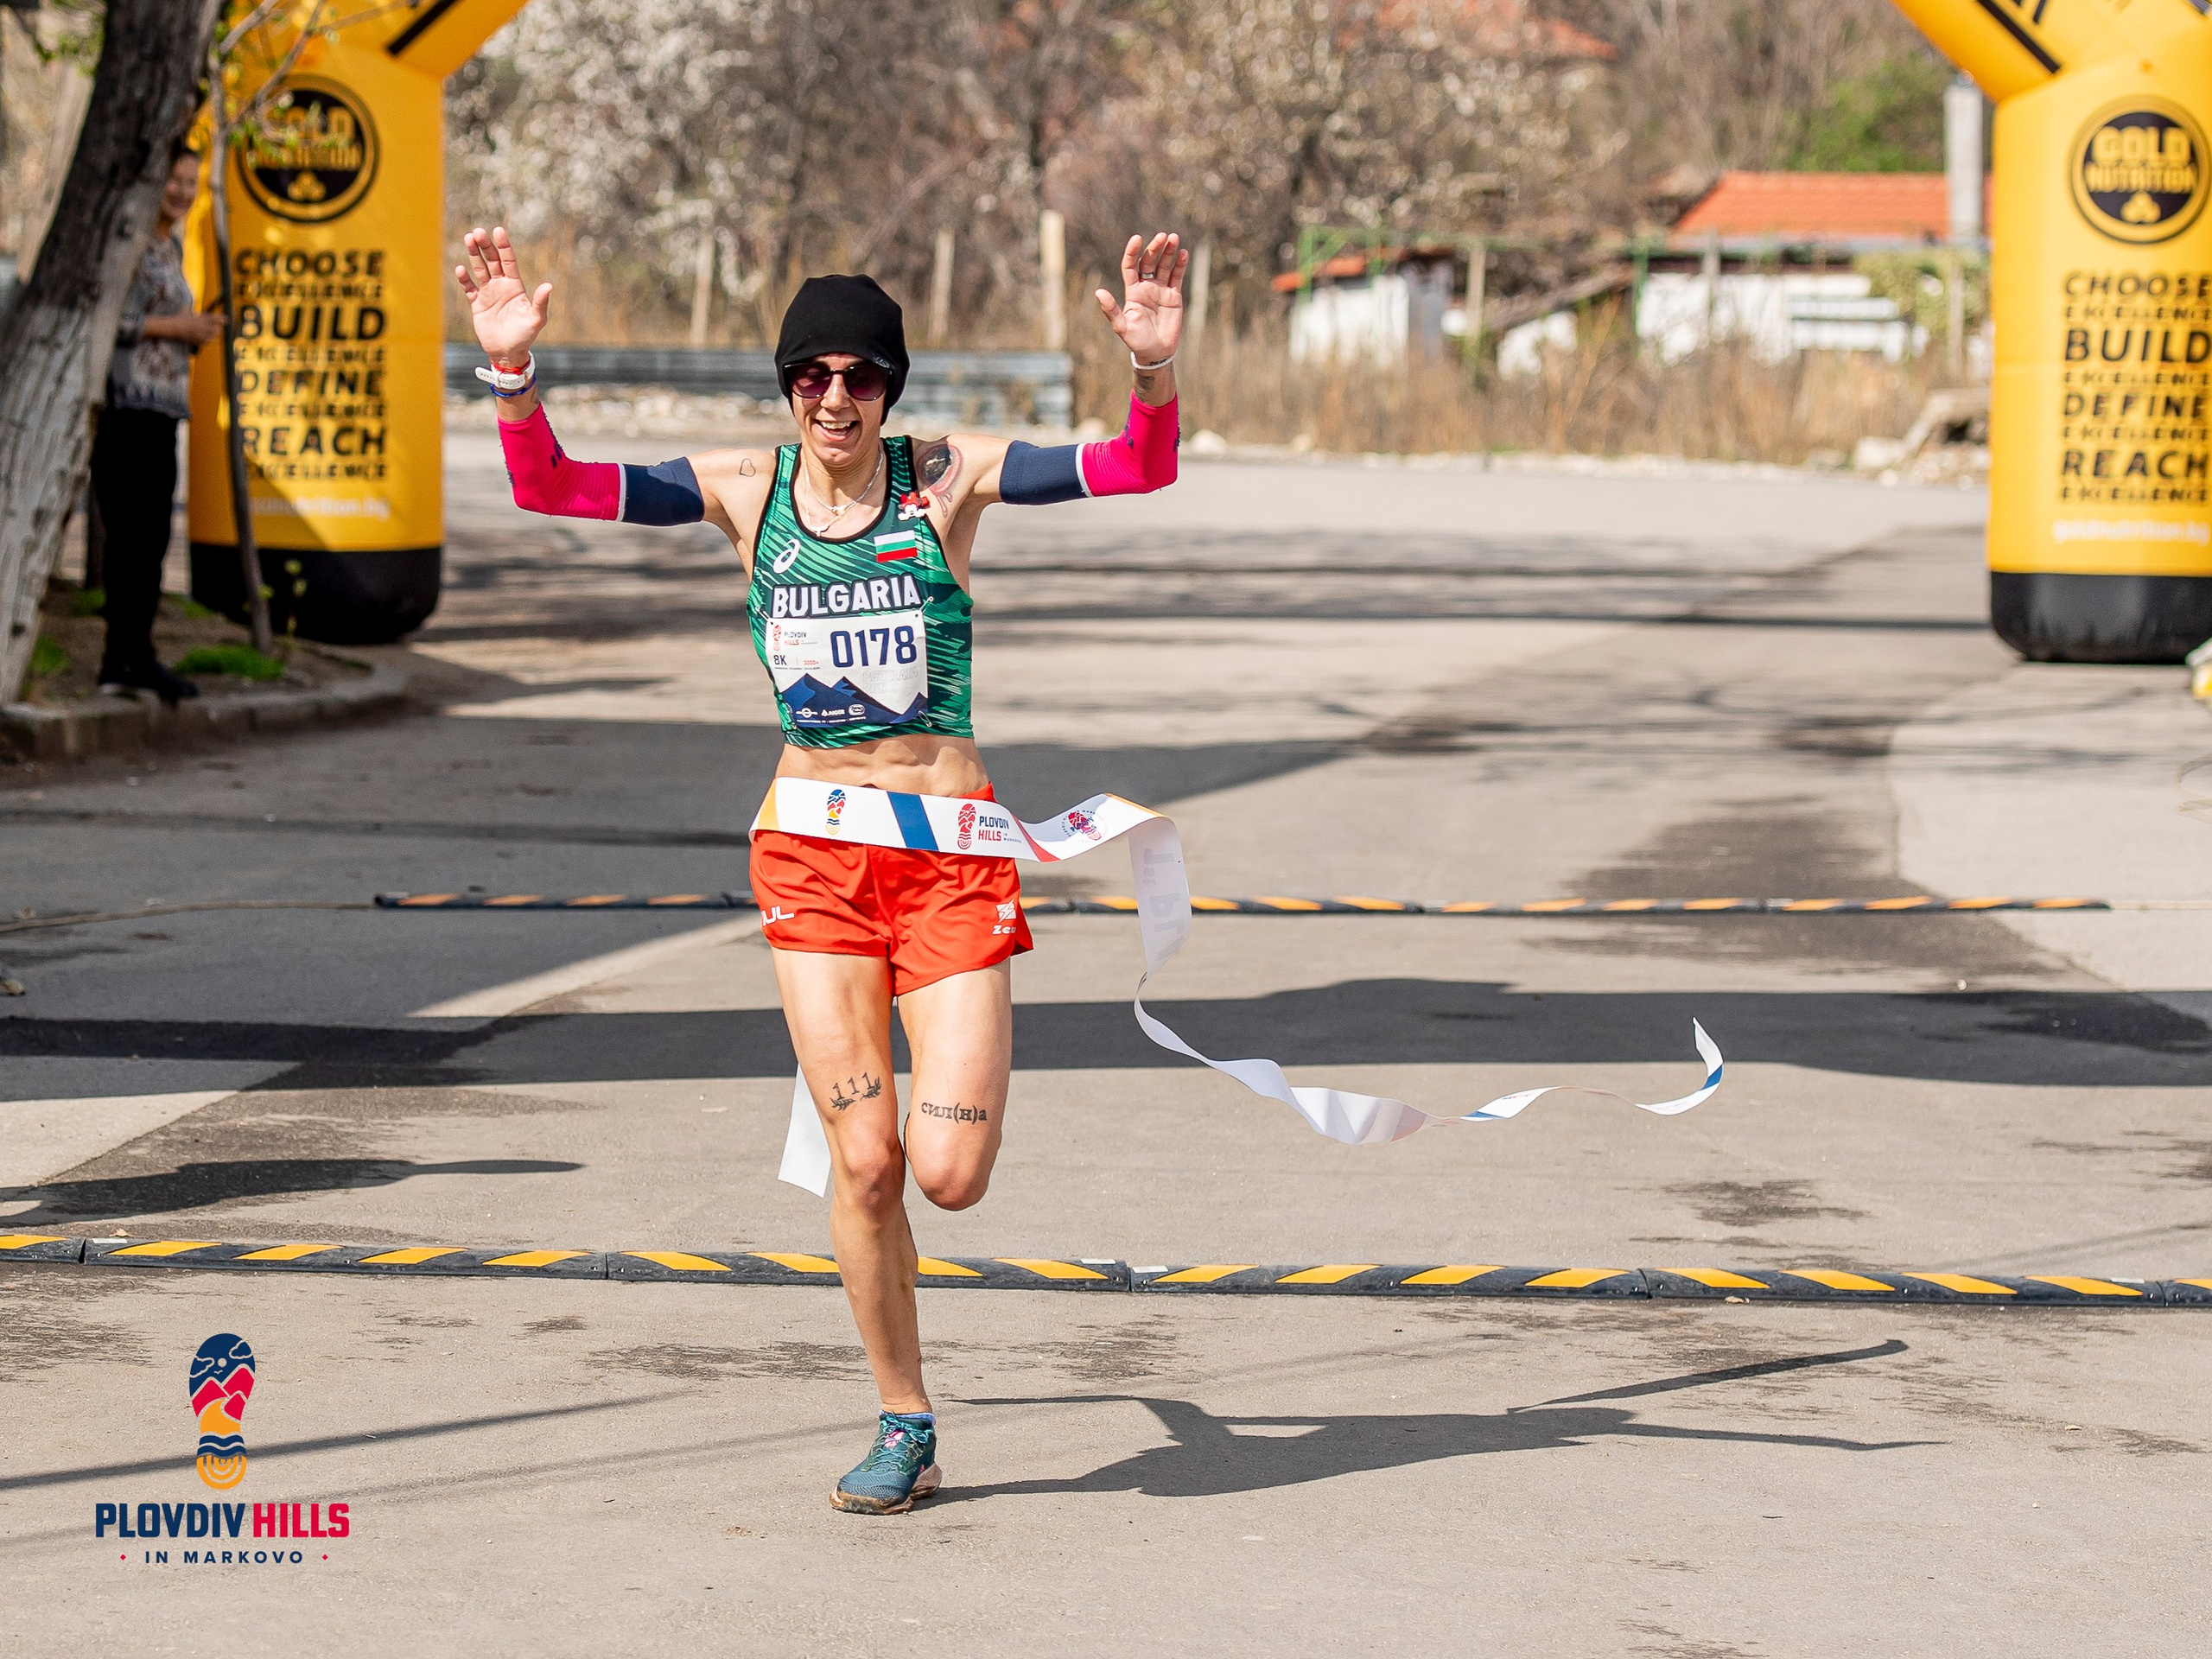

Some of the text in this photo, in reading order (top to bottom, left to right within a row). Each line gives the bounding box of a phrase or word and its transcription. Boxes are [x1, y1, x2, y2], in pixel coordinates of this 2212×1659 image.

[2092, 125, 2191, 164] GOLD
[236, 249, 385, 277] CHOOSE
[2064, 272, 2211, 298] CHOOSE
[240, 305, 385, 340] BUILD
[2064, 329, 2212, 363] BUILD
[240, 369, 385, 397] DEFINE
[2063, 392, 2209, 418] DEFINE
[242, 426, 387, 456] REACH
[2062, 448, 2209, 478] REACH
[771, 574, 922, 619] BULGARIA
[773, 654, 787, 665] 8K
[830, 625, 918, 668] 0178
[978, 830, 1001, 842] HILLS
[979, 816, 1010, 830] PLOVDIV
